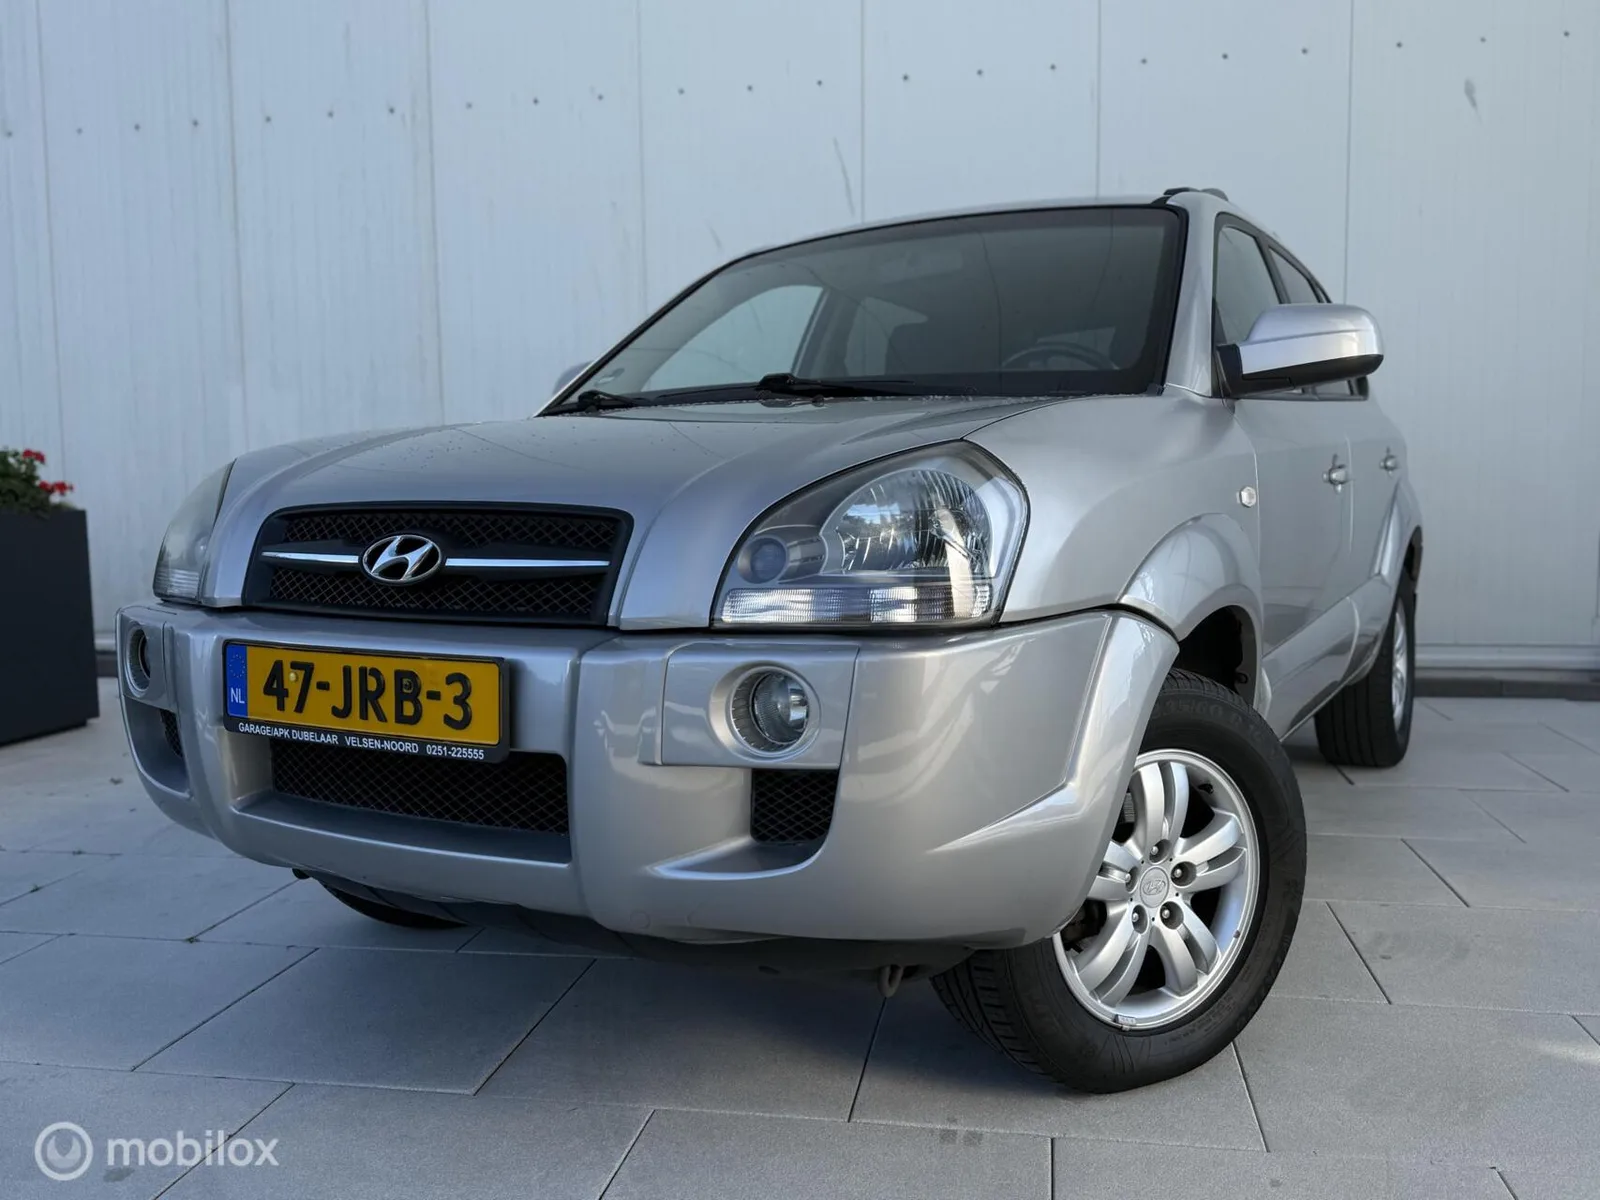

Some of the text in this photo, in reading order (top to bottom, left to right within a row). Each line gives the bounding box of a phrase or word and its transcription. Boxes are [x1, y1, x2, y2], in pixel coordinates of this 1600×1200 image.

[230, 687, 246, 704] NL
[262, 659, 473, 731] 47-JRB-3
[238, 722, 485, 760] GARAGE/APK DUBELAAR VELSEN-NOORD 0251-225555
